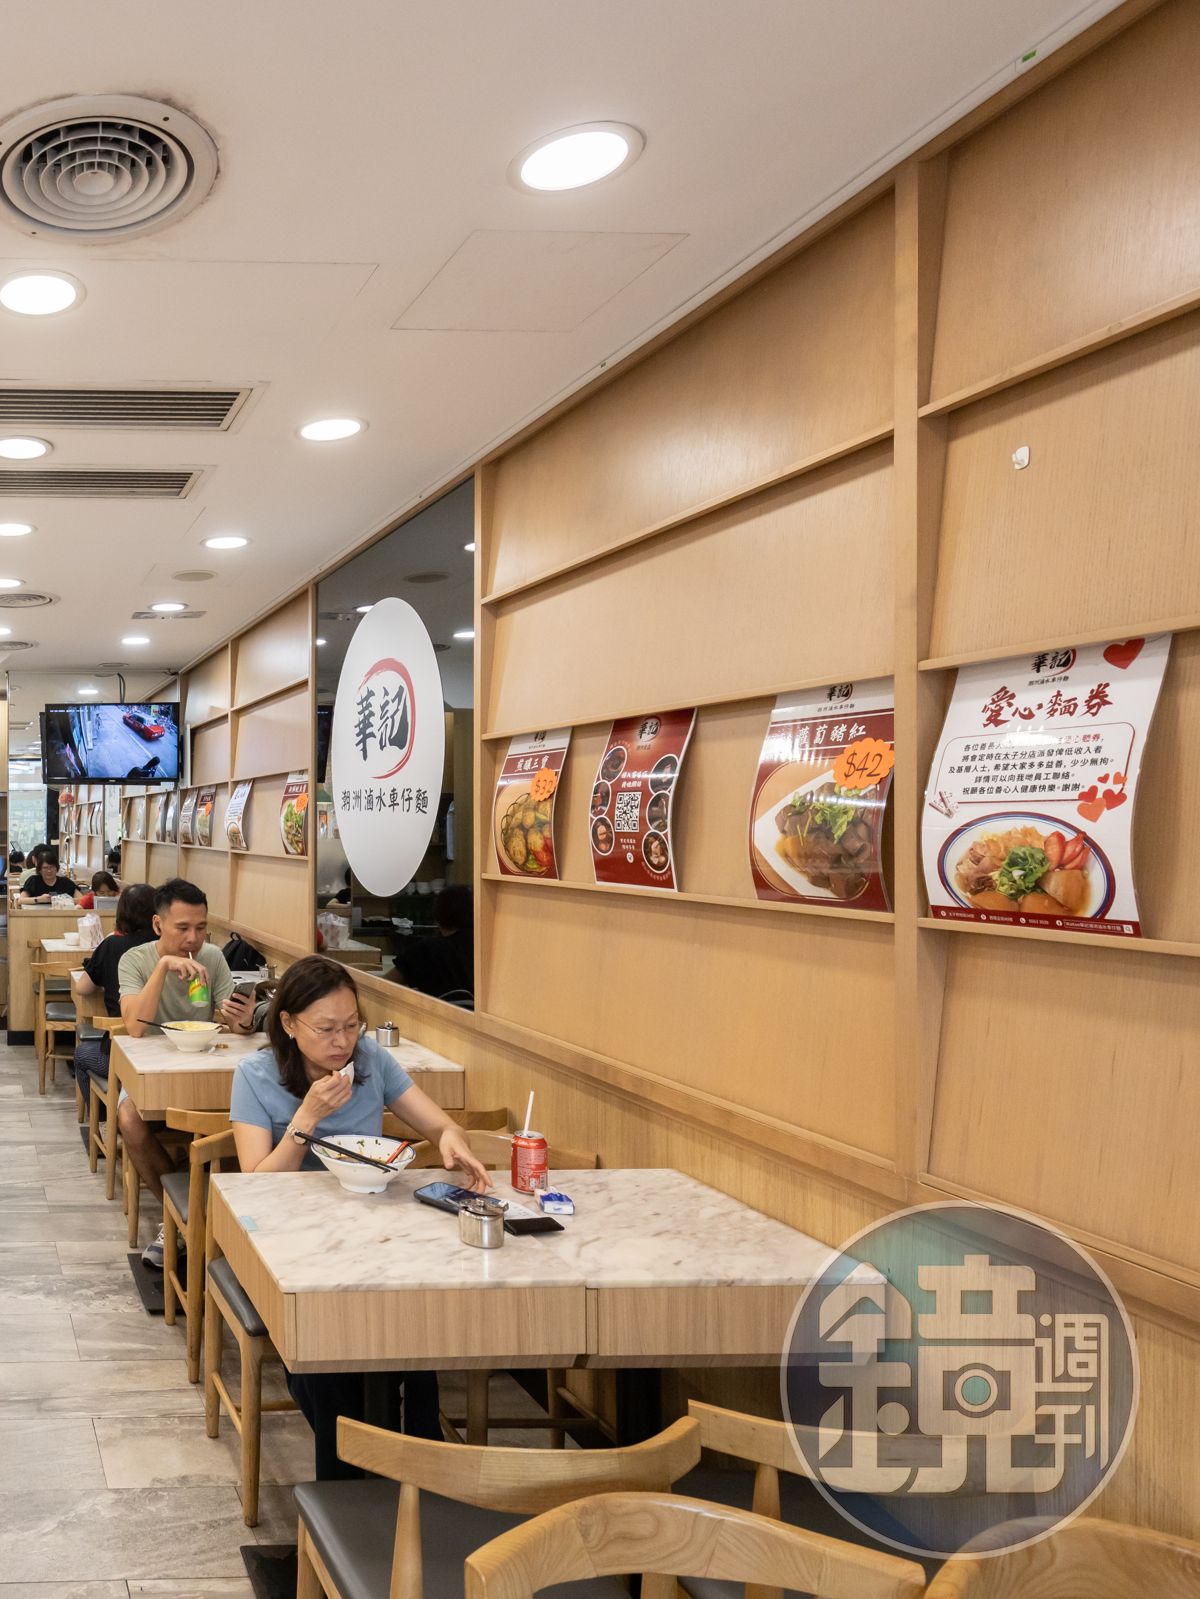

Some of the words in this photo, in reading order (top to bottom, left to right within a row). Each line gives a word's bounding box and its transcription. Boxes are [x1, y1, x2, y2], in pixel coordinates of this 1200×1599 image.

[1031, 651, 1072, 673] 華記
[981, 682, 1113, 728] 愛心麵券
[354, 685, 409, 761] 華記
[844, 750, 883, 779] $42
[341, 787, 429, 815] 潮洲滷水車仔麵
